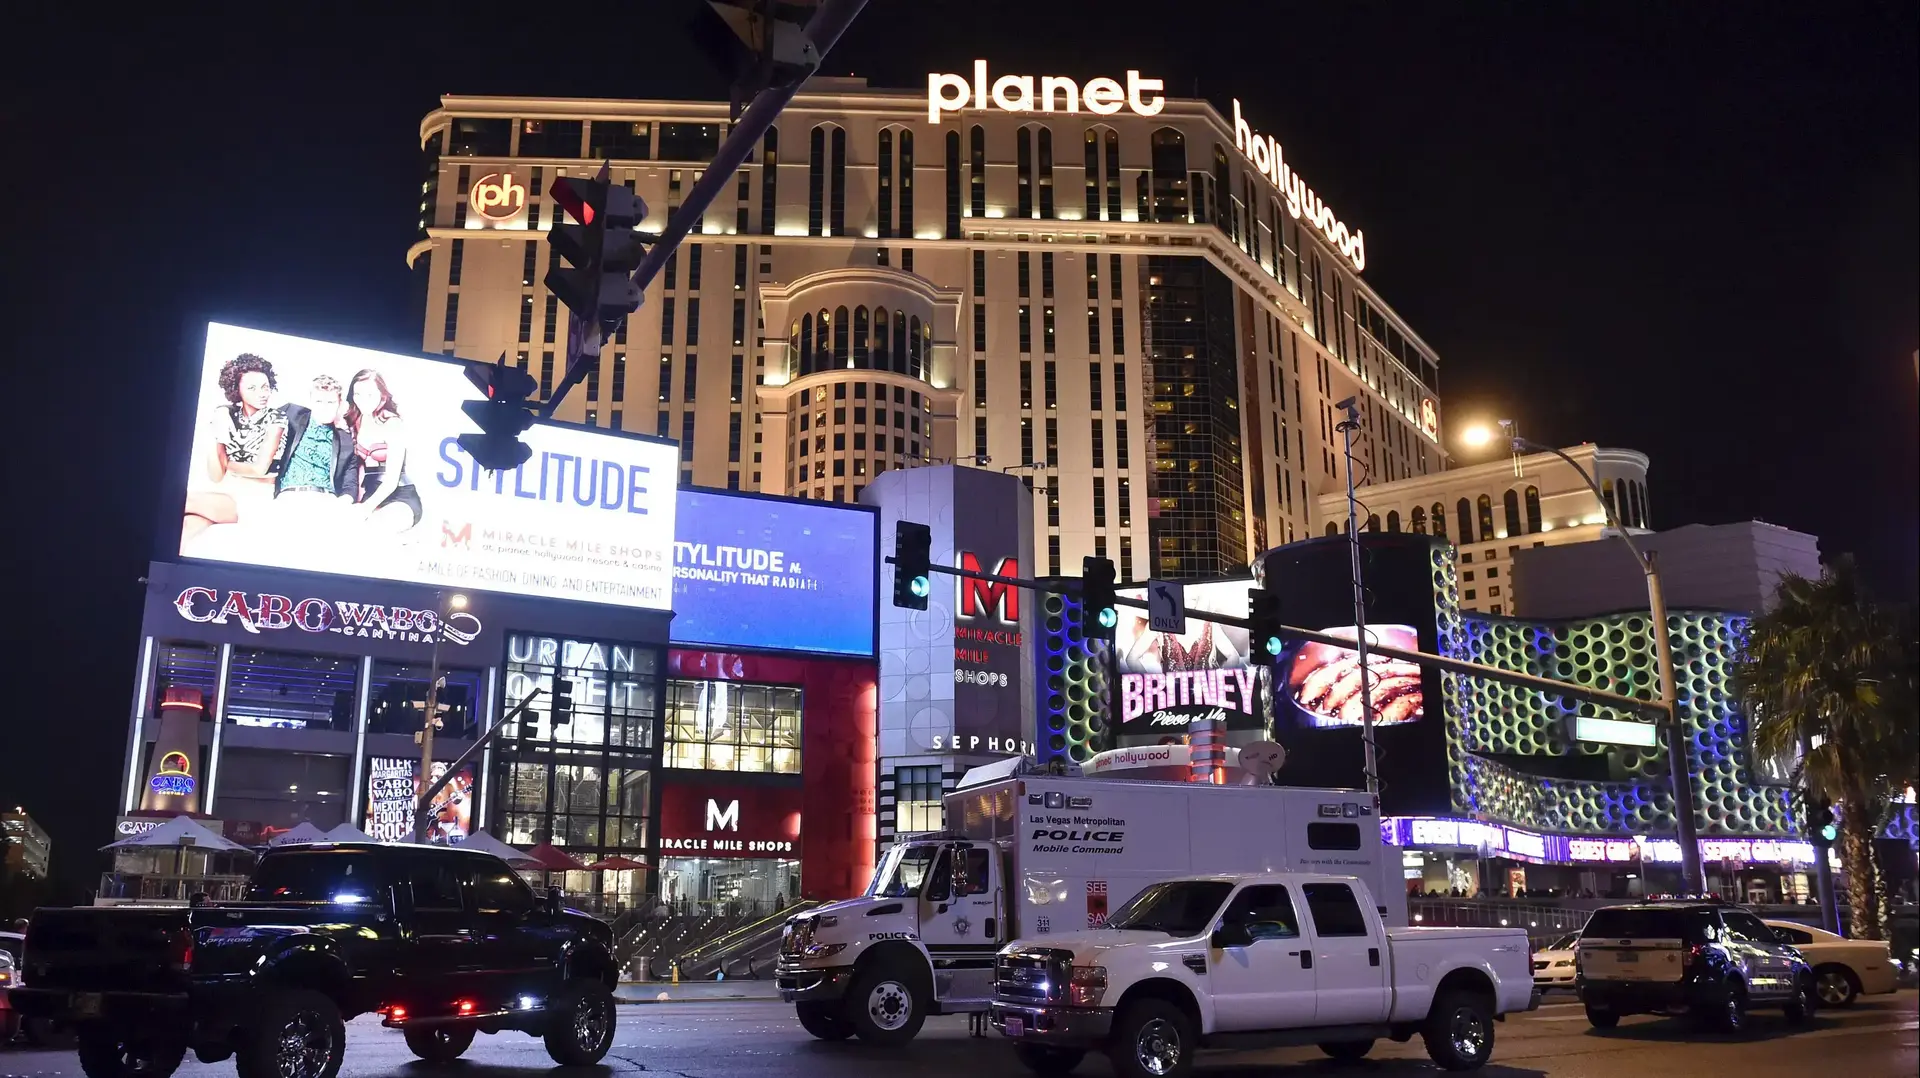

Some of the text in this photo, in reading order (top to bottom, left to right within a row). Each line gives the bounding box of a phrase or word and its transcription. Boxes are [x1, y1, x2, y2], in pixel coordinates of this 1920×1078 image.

[928, 59, 1165, 124] planet
[477, 173, 525, 212] ph
[1233, 98, 1365, 271] hollywood
[436, 436, 650, 515] SLITUDE
[482, 528, 663, 562] MIRACLE MILE SHOPS
[534, 549, 584, 563] hollywood
[586, 556, 620, 568] resort
[622, 560, 629, 568] &
[632, 561, 663, 573] casino
[425, 560, 452, 576] MILE
[457, 565, 470, 578] OF
[522, 574, 557, 589] DINING
[561, 578, 583, 593] AND
[585, 579, 663, 602] ENTERTAINMENT
[740, 572, 770, 586] THAT
[956, 551, 1019, 624] M
[173, 586, 439, 634] CABO WABO
[1154, 616, 1180, 630] ONLY
[343, 627, 434, 644] CANTINA
[955, 626, 1022, 647] MIRACLE
[955, 647, 989, 664] MILE
[955, 668, 1008, 687] SHOPS
[1121, 667, 1257, 723] BRITNEY
[1150, 710, 1190, 727] Piece
[933, 735, 1036, 757] SEPHORA
[371, 757, 412, 771] KILLER
[1114, 750, 1170, 765] hollywood
[372, 787, 413, 799] WABO
[373, 779, 413, 790] CABO
[373, 800, 417, 813] MEXICAN
[707, 799, 739, 831] M
[373, 809, 415, 824] FOOD &
[1030, 815, 1126, 827] Las Vegas Metropolitan
[118, 820, 165, 835] CAB
[374, 821, 415, 840] ROCK
[1032, 829, 1125, 842] POLICE
[713, 840, 743, 850] MILE
[749, 841, 792, 851] SHOPS
[1032, 844, 1124, 854] Mobile Command
[1087, 882, 1108, 893] SEE
[1087, 912, 1109, 925] SAY
[869, 932, 906, 941] POLICE
